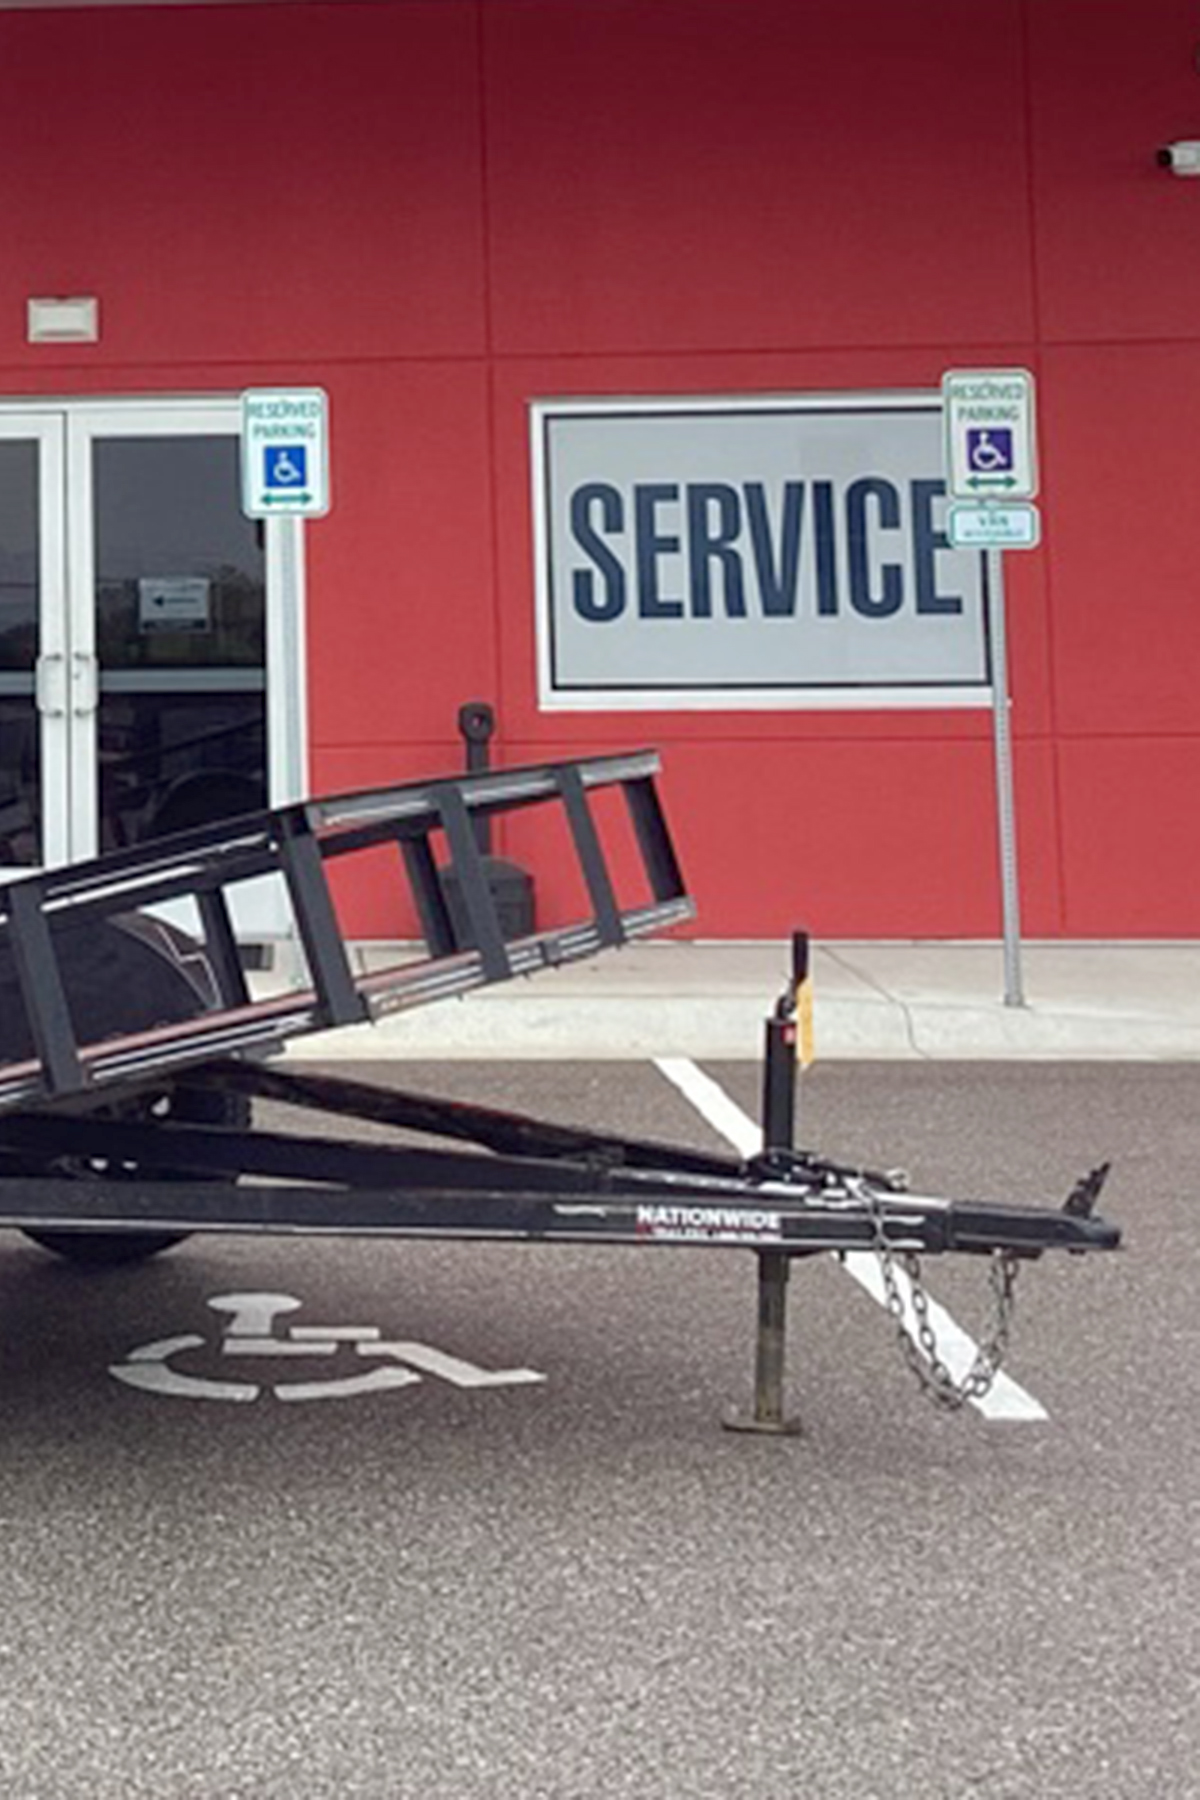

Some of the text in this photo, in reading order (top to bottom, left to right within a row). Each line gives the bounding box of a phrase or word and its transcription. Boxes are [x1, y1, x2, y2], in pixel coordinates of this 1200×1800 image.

[952, 384, 1023, 399] RESERVED
[246, 402, 322, 418] RESERVED
[958, 406, 1019, 421] PARKING
[253, 422, 315, 438] PARKING
[569, 476, 963, 622] SERVICE
[636, 1204, 780, 1229] NATIONWIDE
